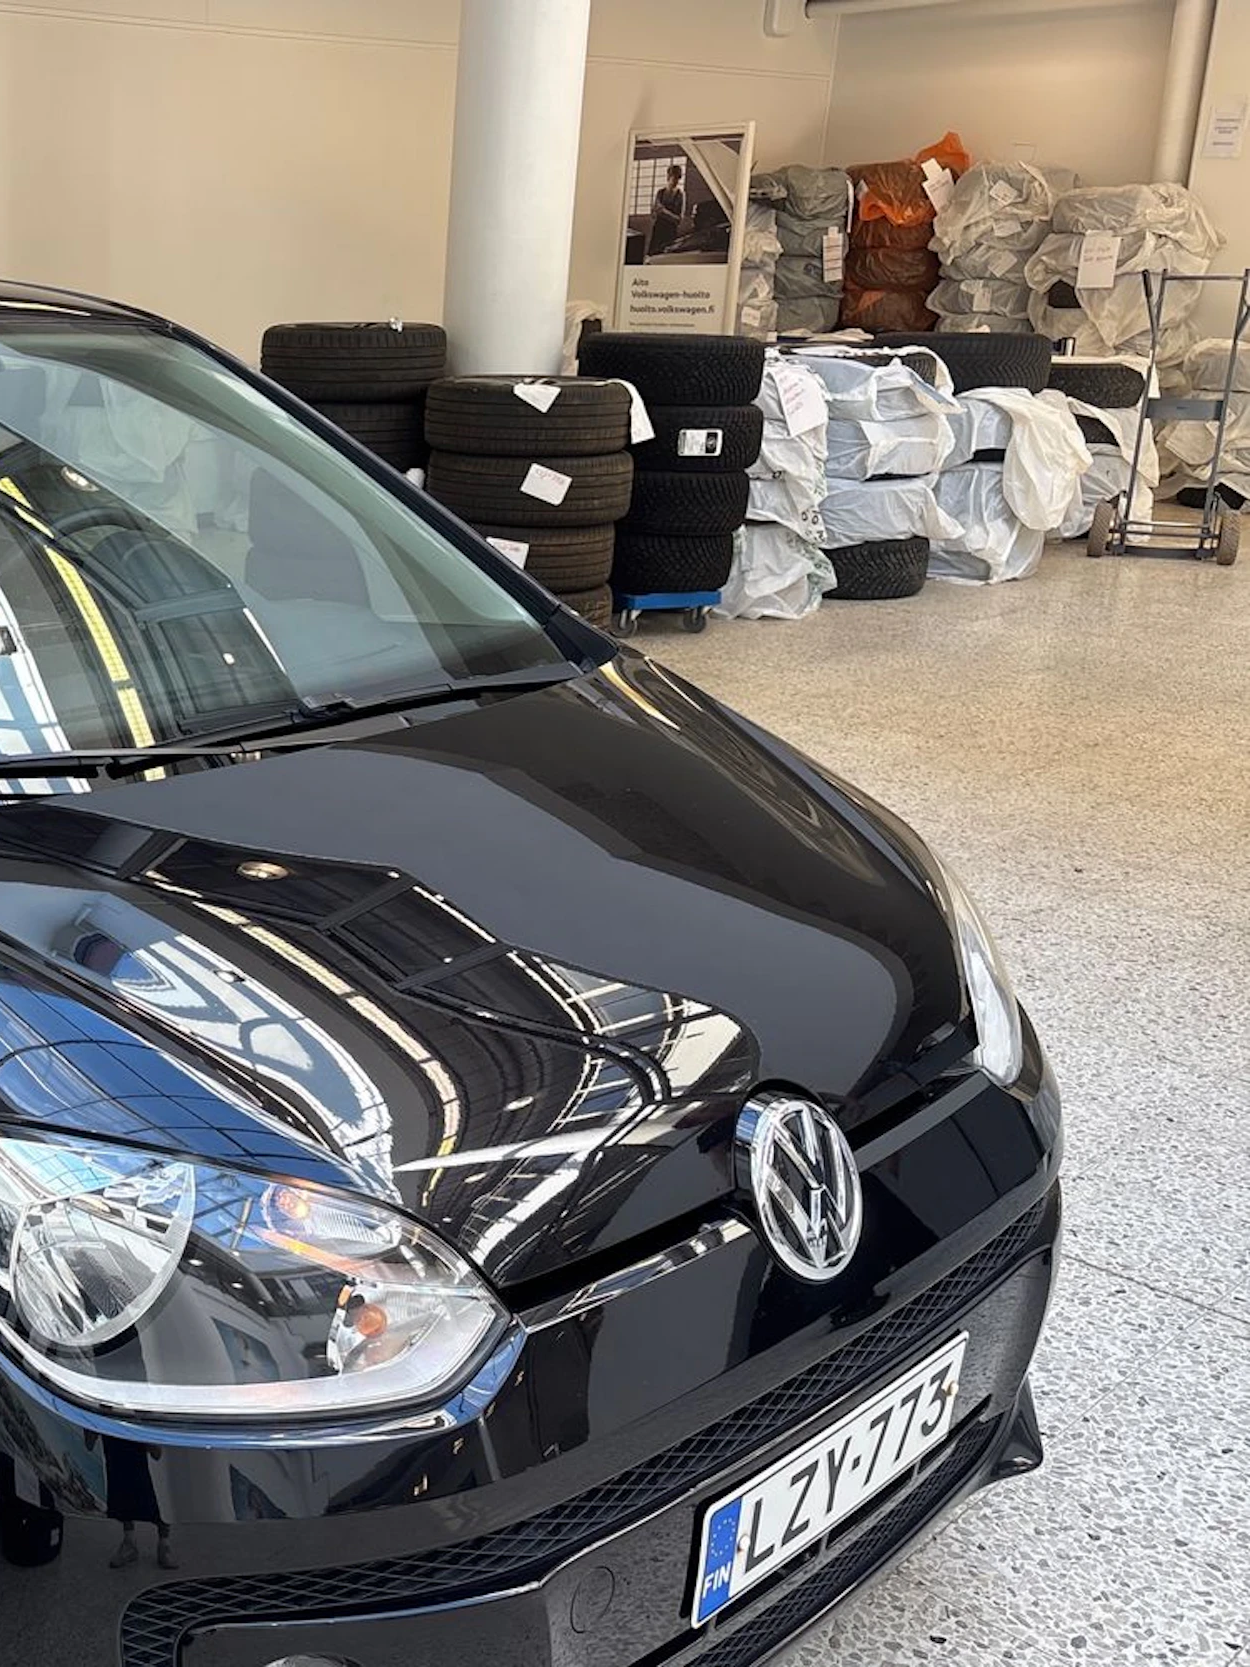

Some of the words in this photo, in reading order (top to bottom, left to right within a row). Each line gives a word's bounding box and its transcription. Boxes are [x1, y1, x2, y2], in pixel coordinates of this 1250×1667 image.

[631, 290, 710, 300] Volkswagen-huolto
[630, 305, 715, 314] huolto.volkswagen.fi
[744, 1361, 953, 1574] LZY-773
[701, 1562, 731, 1600] FIN
